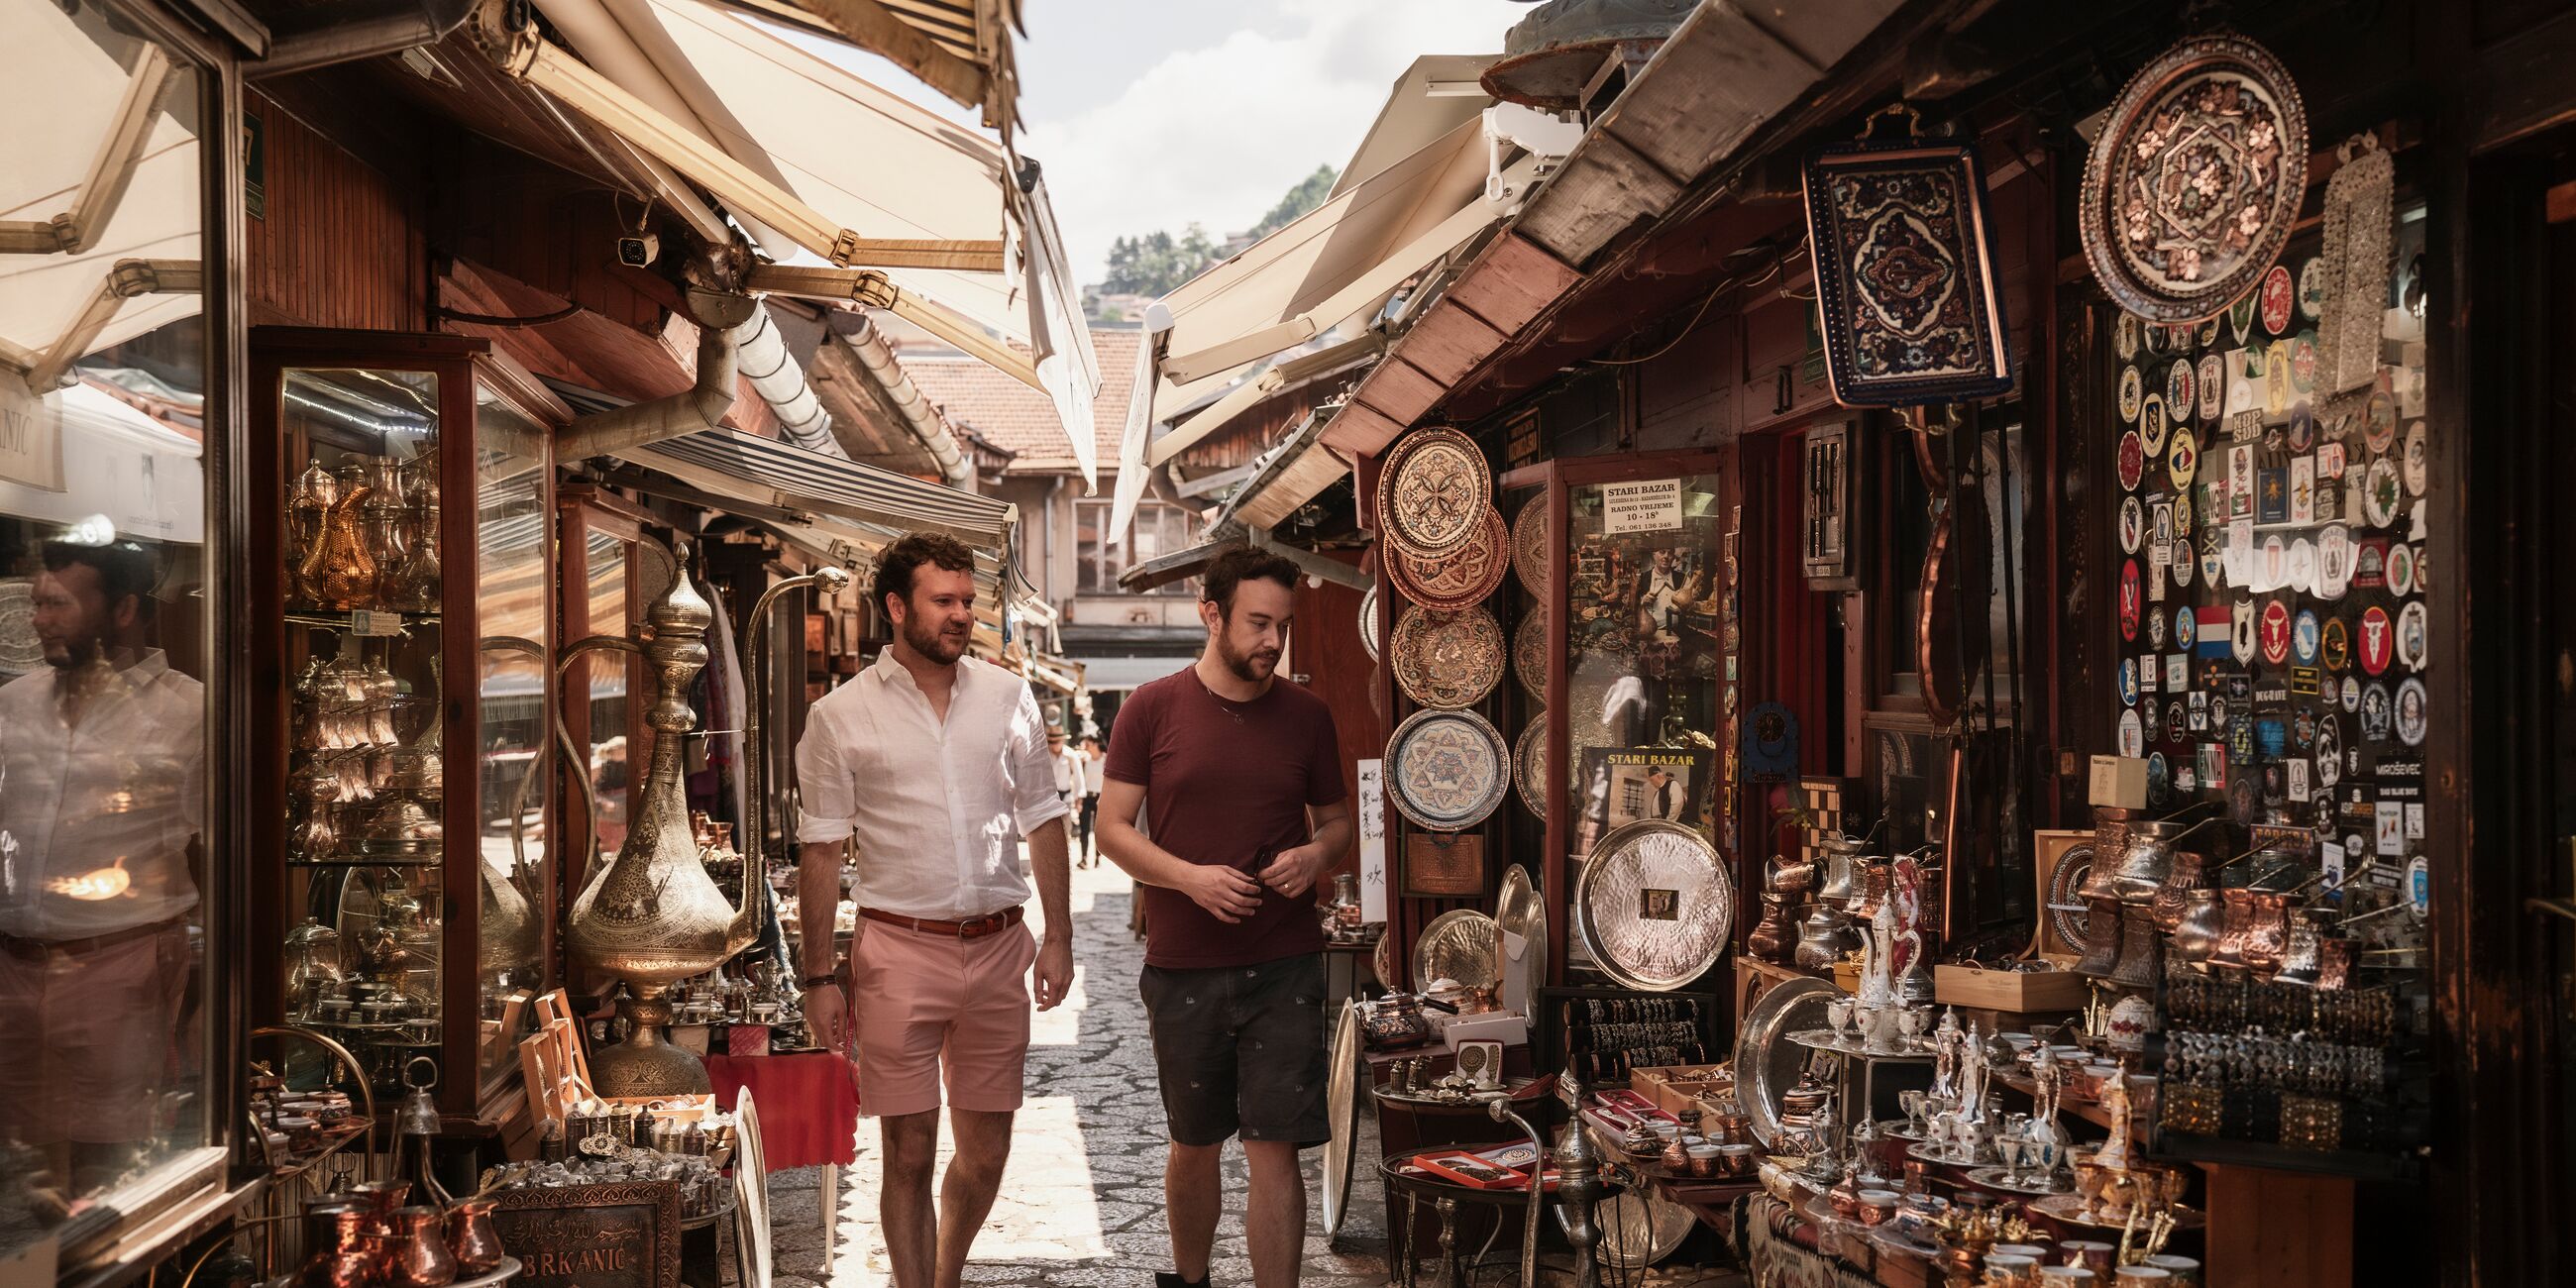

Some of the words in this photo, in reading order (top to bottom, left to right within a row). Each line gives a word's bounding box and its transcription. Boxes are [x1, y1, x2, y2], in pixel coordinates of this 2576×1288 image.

[2233, 410, 2261, 429] HOP
[0, 403, 33, 457] NIĆ
[2233, 423, 2261, 443] SUD
[1608, 486, 1639, 496] STARI
[1641, 483, 1675, 493] BAZAR
[1608, 754, 1646, 765] STARI
[1650, 755, 1694, 765] BAZAR
[2376, 761, 2421, 776] MIROŠEVEC
[522, 1239, 626, 1278] BRKANIĆ
